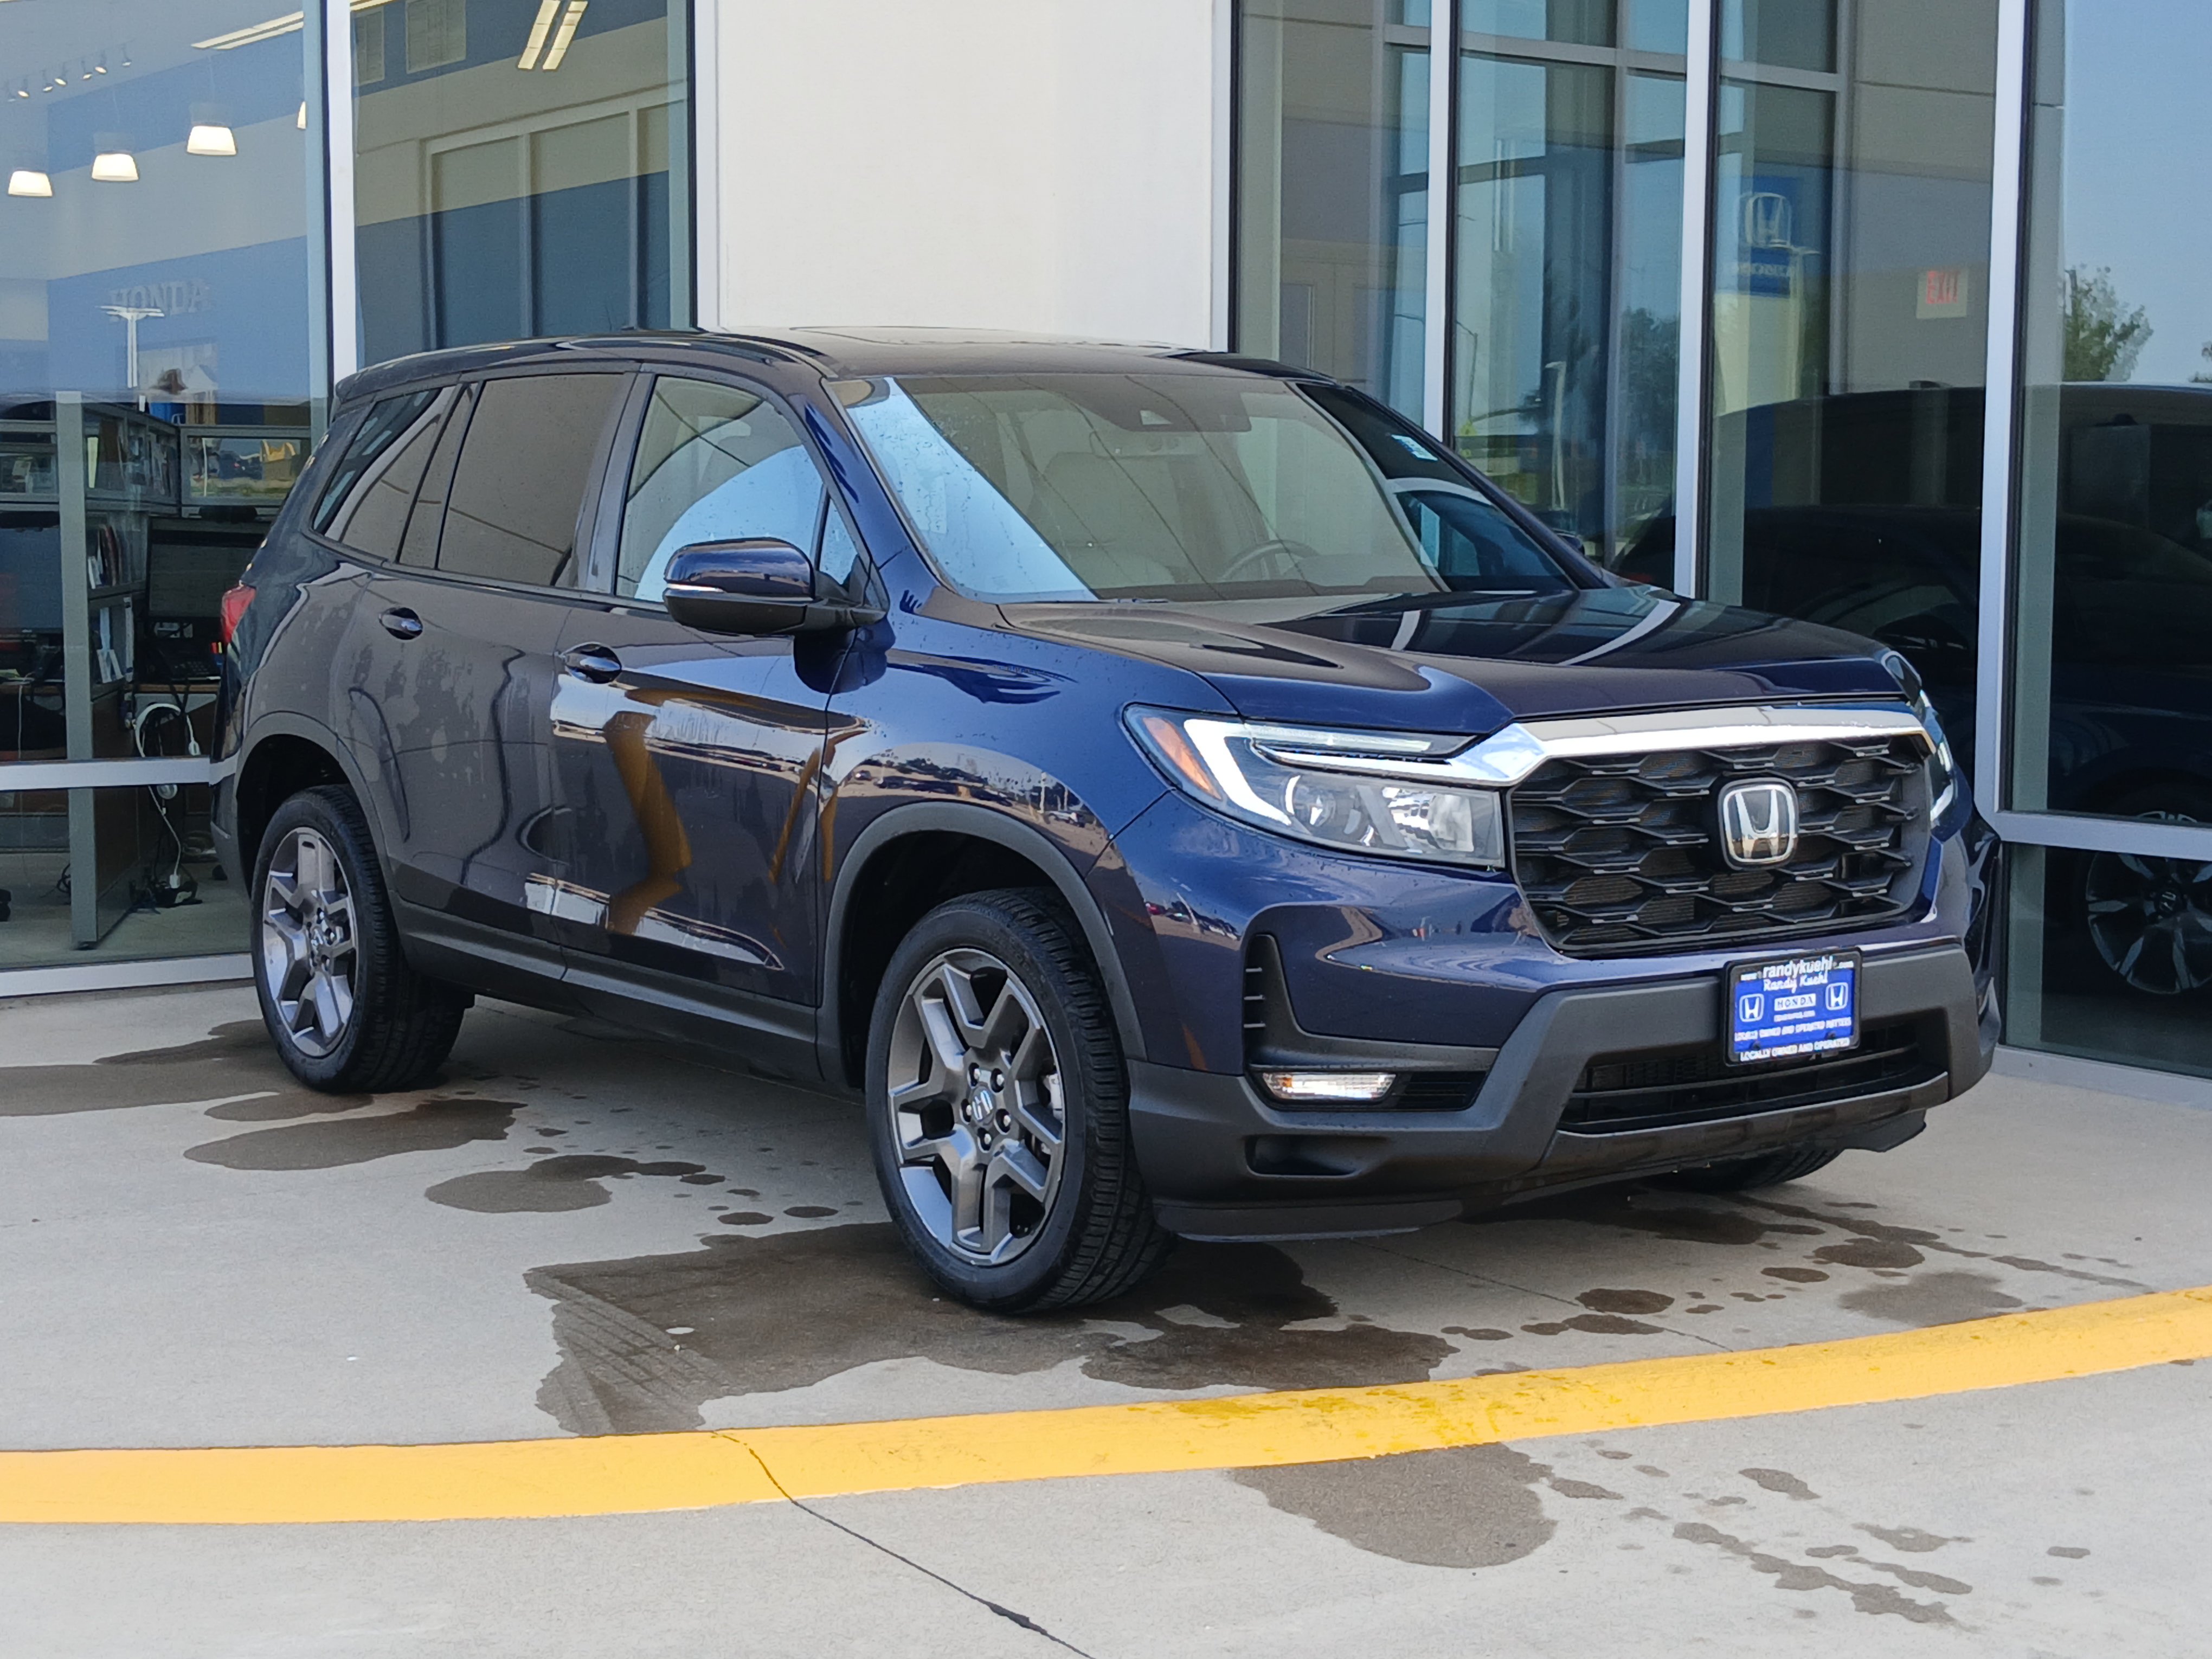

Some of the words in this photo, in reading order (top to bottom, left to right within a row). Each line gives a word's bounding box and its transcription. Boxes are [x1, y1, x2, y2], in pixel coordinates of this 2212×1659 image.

[109, 279, 216, 316] HONDA
[1926, 270, 1960, 304] EXIT
[1763, 956, 1833, 979] randykuehl
[1764, 978, 1797, 993] Randy
[1799, 972, 1828, 987] Kuehl
[1777, 995, 1814, 1008] HONDA
